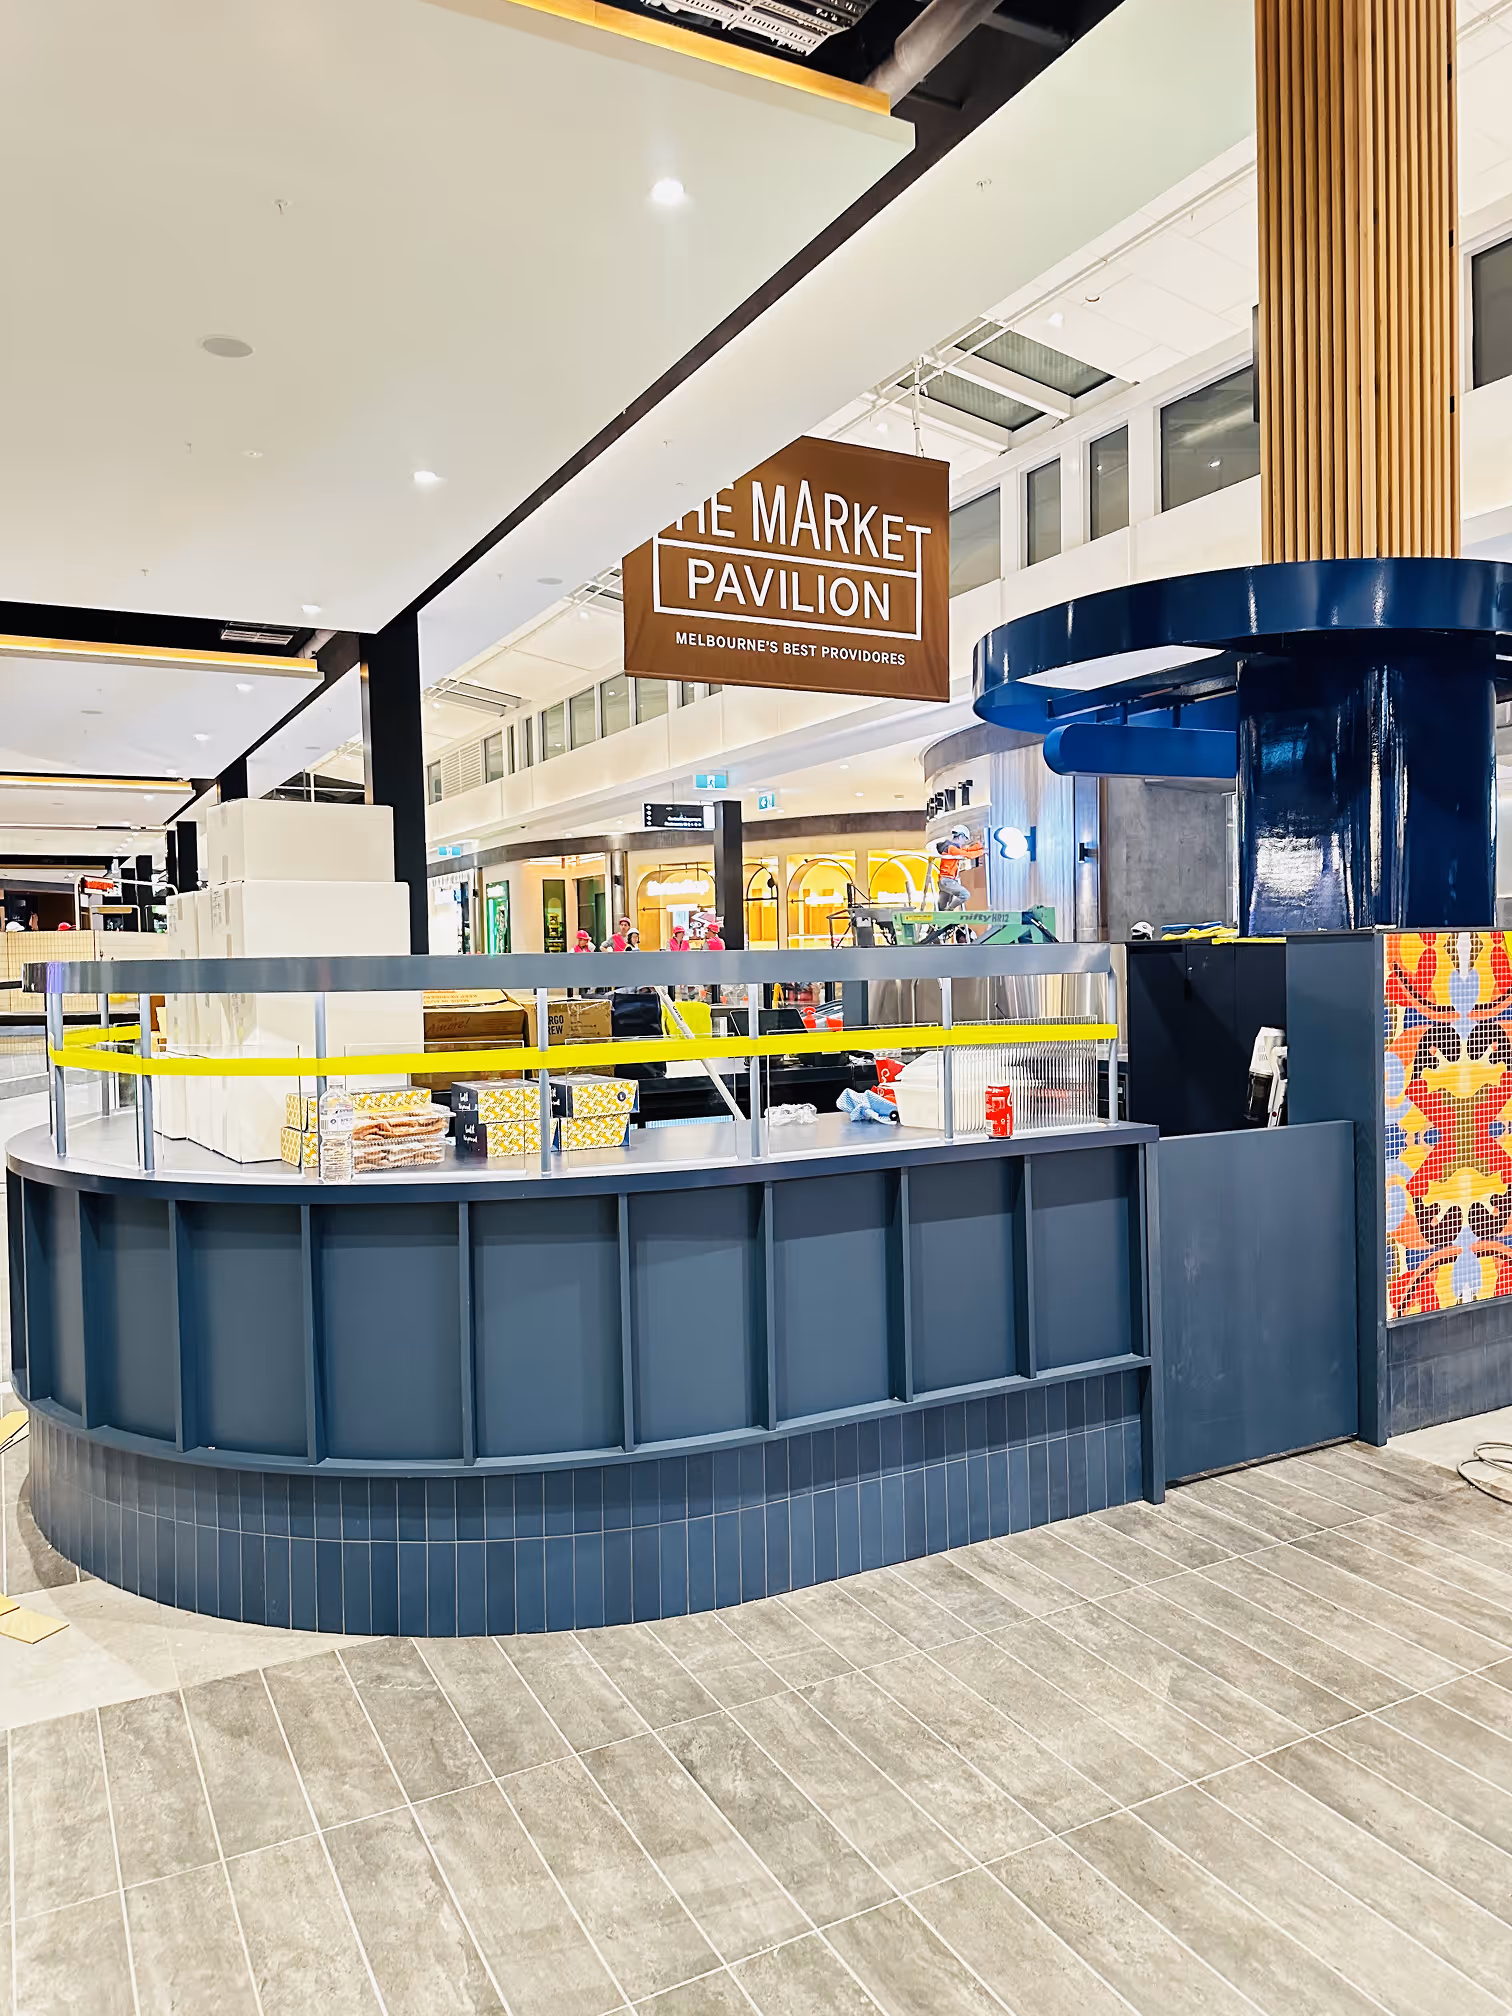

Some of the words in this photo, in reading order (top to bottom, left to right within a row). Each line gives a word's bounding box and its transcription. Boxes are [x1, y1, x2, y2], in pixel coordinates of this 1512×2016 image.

[752, 479, 932, 570] MARKET
[688, 557, 890, 621] PAVILION
[676, 631, 778, 654] MELBOURNE'S
[783, 642, 817, 657] BEST
[821, 646, 905, 666] PROVIDORES
[960, 913, 992, 922] nifty
[548, 1015, 564, 1025] RGO
[548, 1025, 563, 1035] REW
